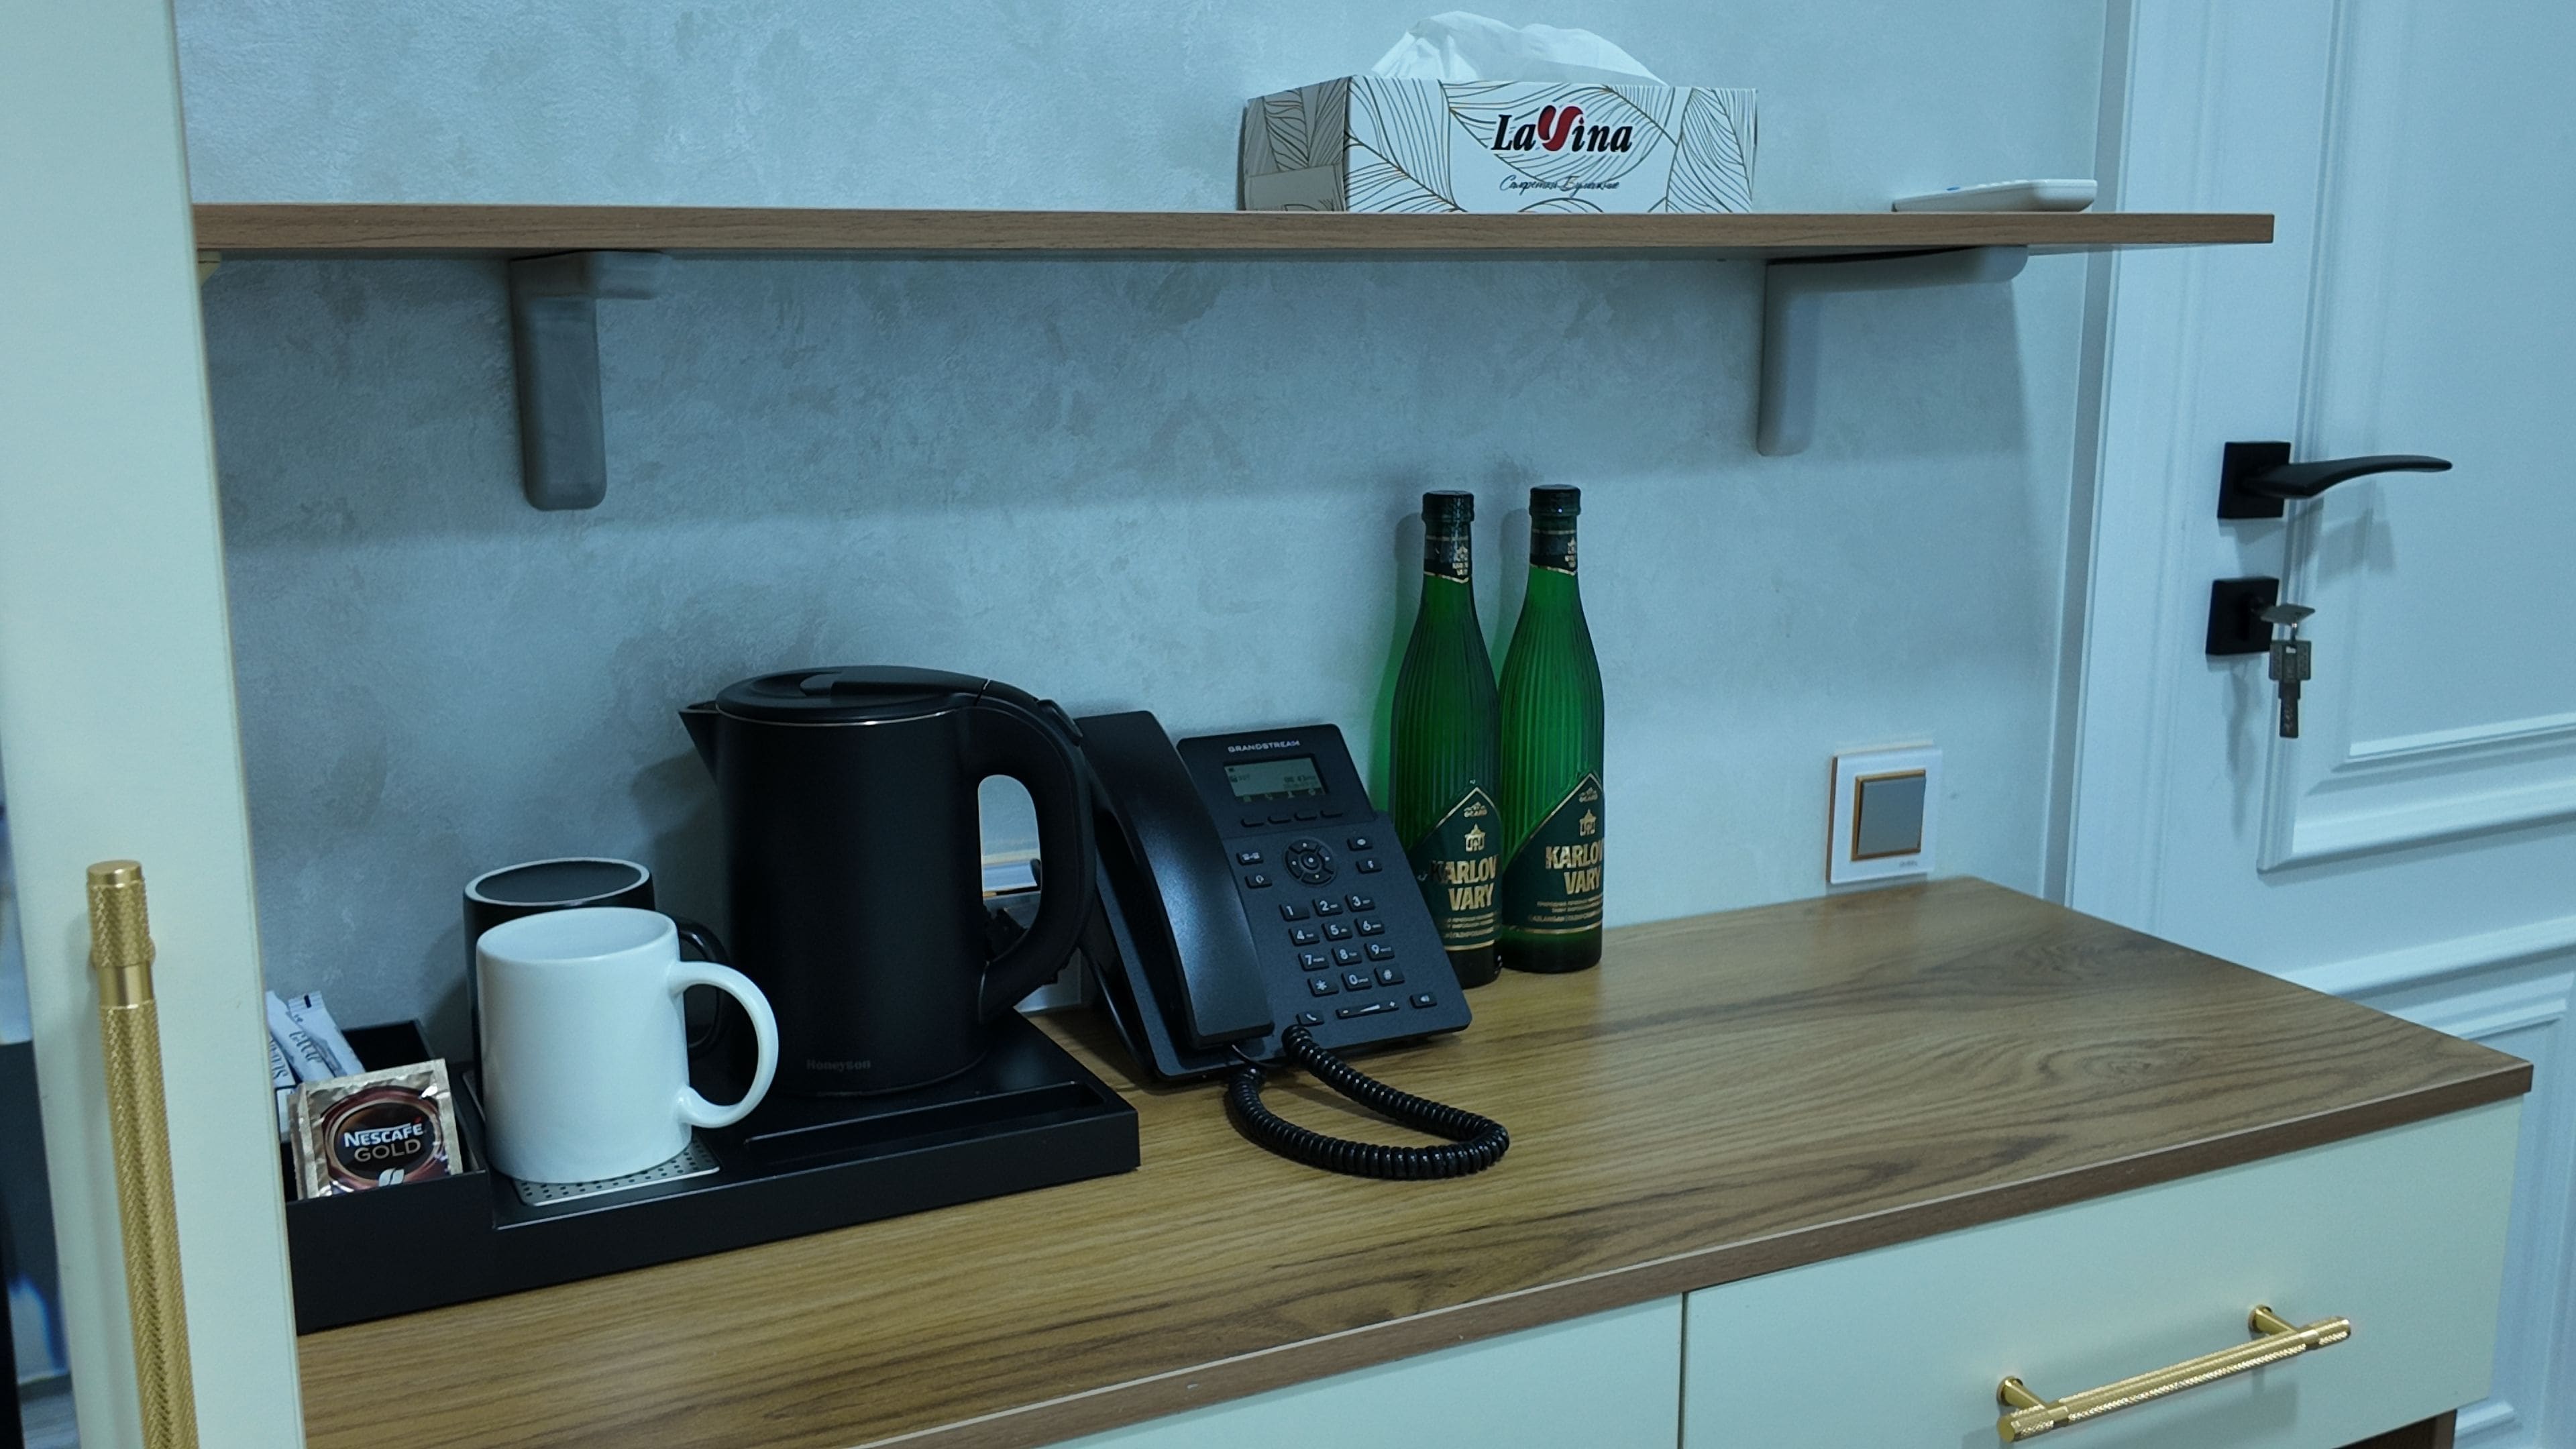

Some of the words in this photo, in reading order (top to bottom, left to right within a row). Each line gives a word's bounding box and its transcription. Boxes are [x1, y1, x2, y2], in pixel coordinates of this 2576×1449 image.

[1228, 740, 1300, 753] GRANDSTREAM
[1564, 865, 1601, 896] VARY
[1352, 896, 1362, 906] 3
[1448, 883, 1494, 911] VARY
[1286, 906, 1294, 916] 1
[1320, 900, 1330, 911] 2
[1330, 924, 1340, 935] 5
[1362, 920, 1372, 931] 6
[1297, 930, 1305, 940] 4
[1339, 949, 1348, 959] 8
[1371, 944, 1380, 955] 9
[1304, 954, 1313, 965] 7
[1348, 974, 1358, 985] 0
[354, 1138, 421, 1162] GOLD
